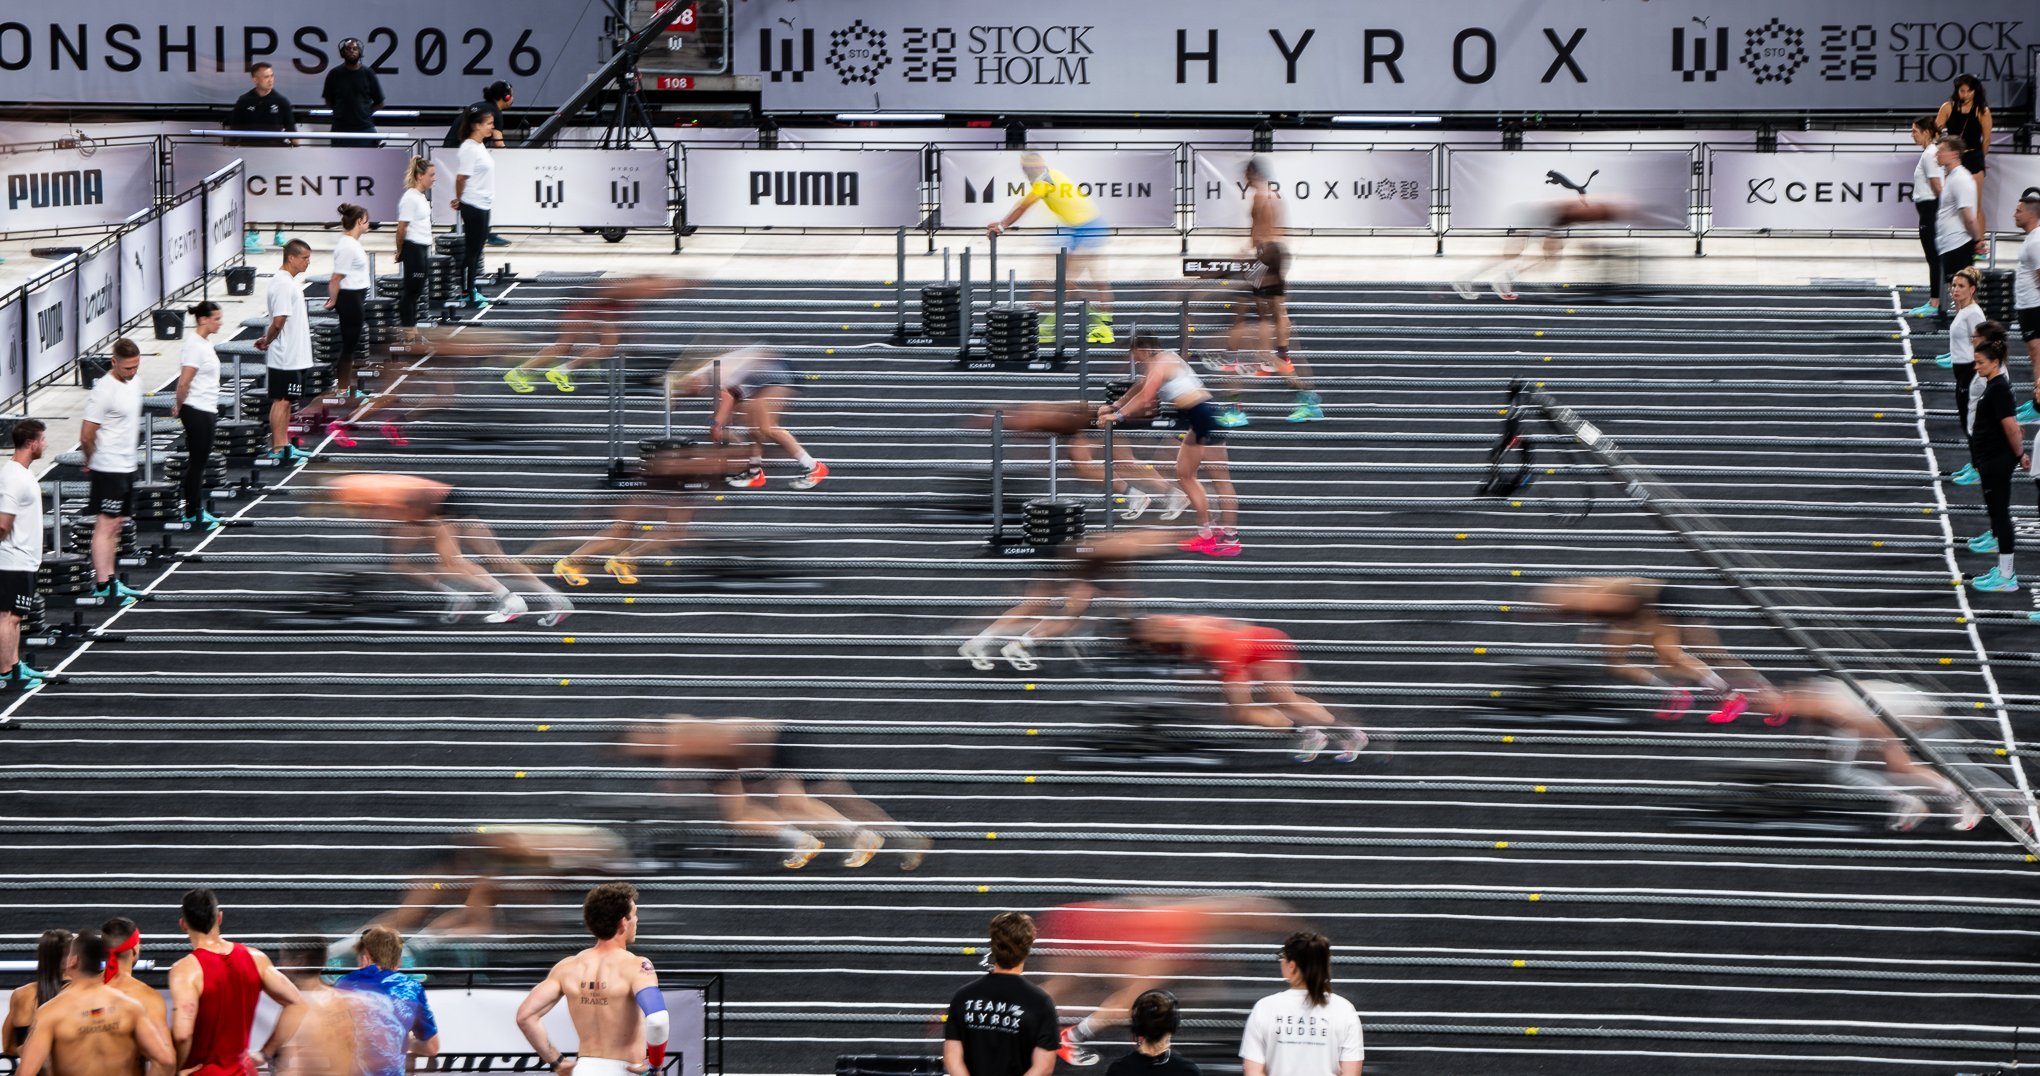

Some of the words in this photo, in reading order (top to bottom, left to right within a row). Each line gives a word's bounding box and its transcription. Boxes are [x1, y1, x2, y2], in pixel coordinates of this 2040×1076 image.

[969, 26, 1095, 55] STOCK
[1889, 21, 2025, 52] STOCK
[367, 26, 541, 77] 2026
[848, 48, 870, 59] STO
[1175, 27, 1588, 85] HYROX
[1764, 47, 1786, 57] STO
[973, 56, 1092, 85] HOLM
[1895, 53, 2017, 83] HOLM
[664, 77, 688, 89] 108
[8, 168, 104, 210] PUMA
[247, 175, 376, 196] CENTR
[750, 170, 860, 207] PUMA
[1007, 181, 1152, 198] MPROTEIN
[1206, 180, 1340, 200] HYROX
[1785, 181, 1915, 203] CENTR
[37, 300, 64, 353] PUMA
[581, 996, 609, 1006] FRANCE
[964, 999, 1007, 1014] TEAM
[964, 1011, 1021, 1029] HYROX
[1276, 1015, 1316, 1025] HEAD
[1275, 1026, 1328, 1037] JUDGE
